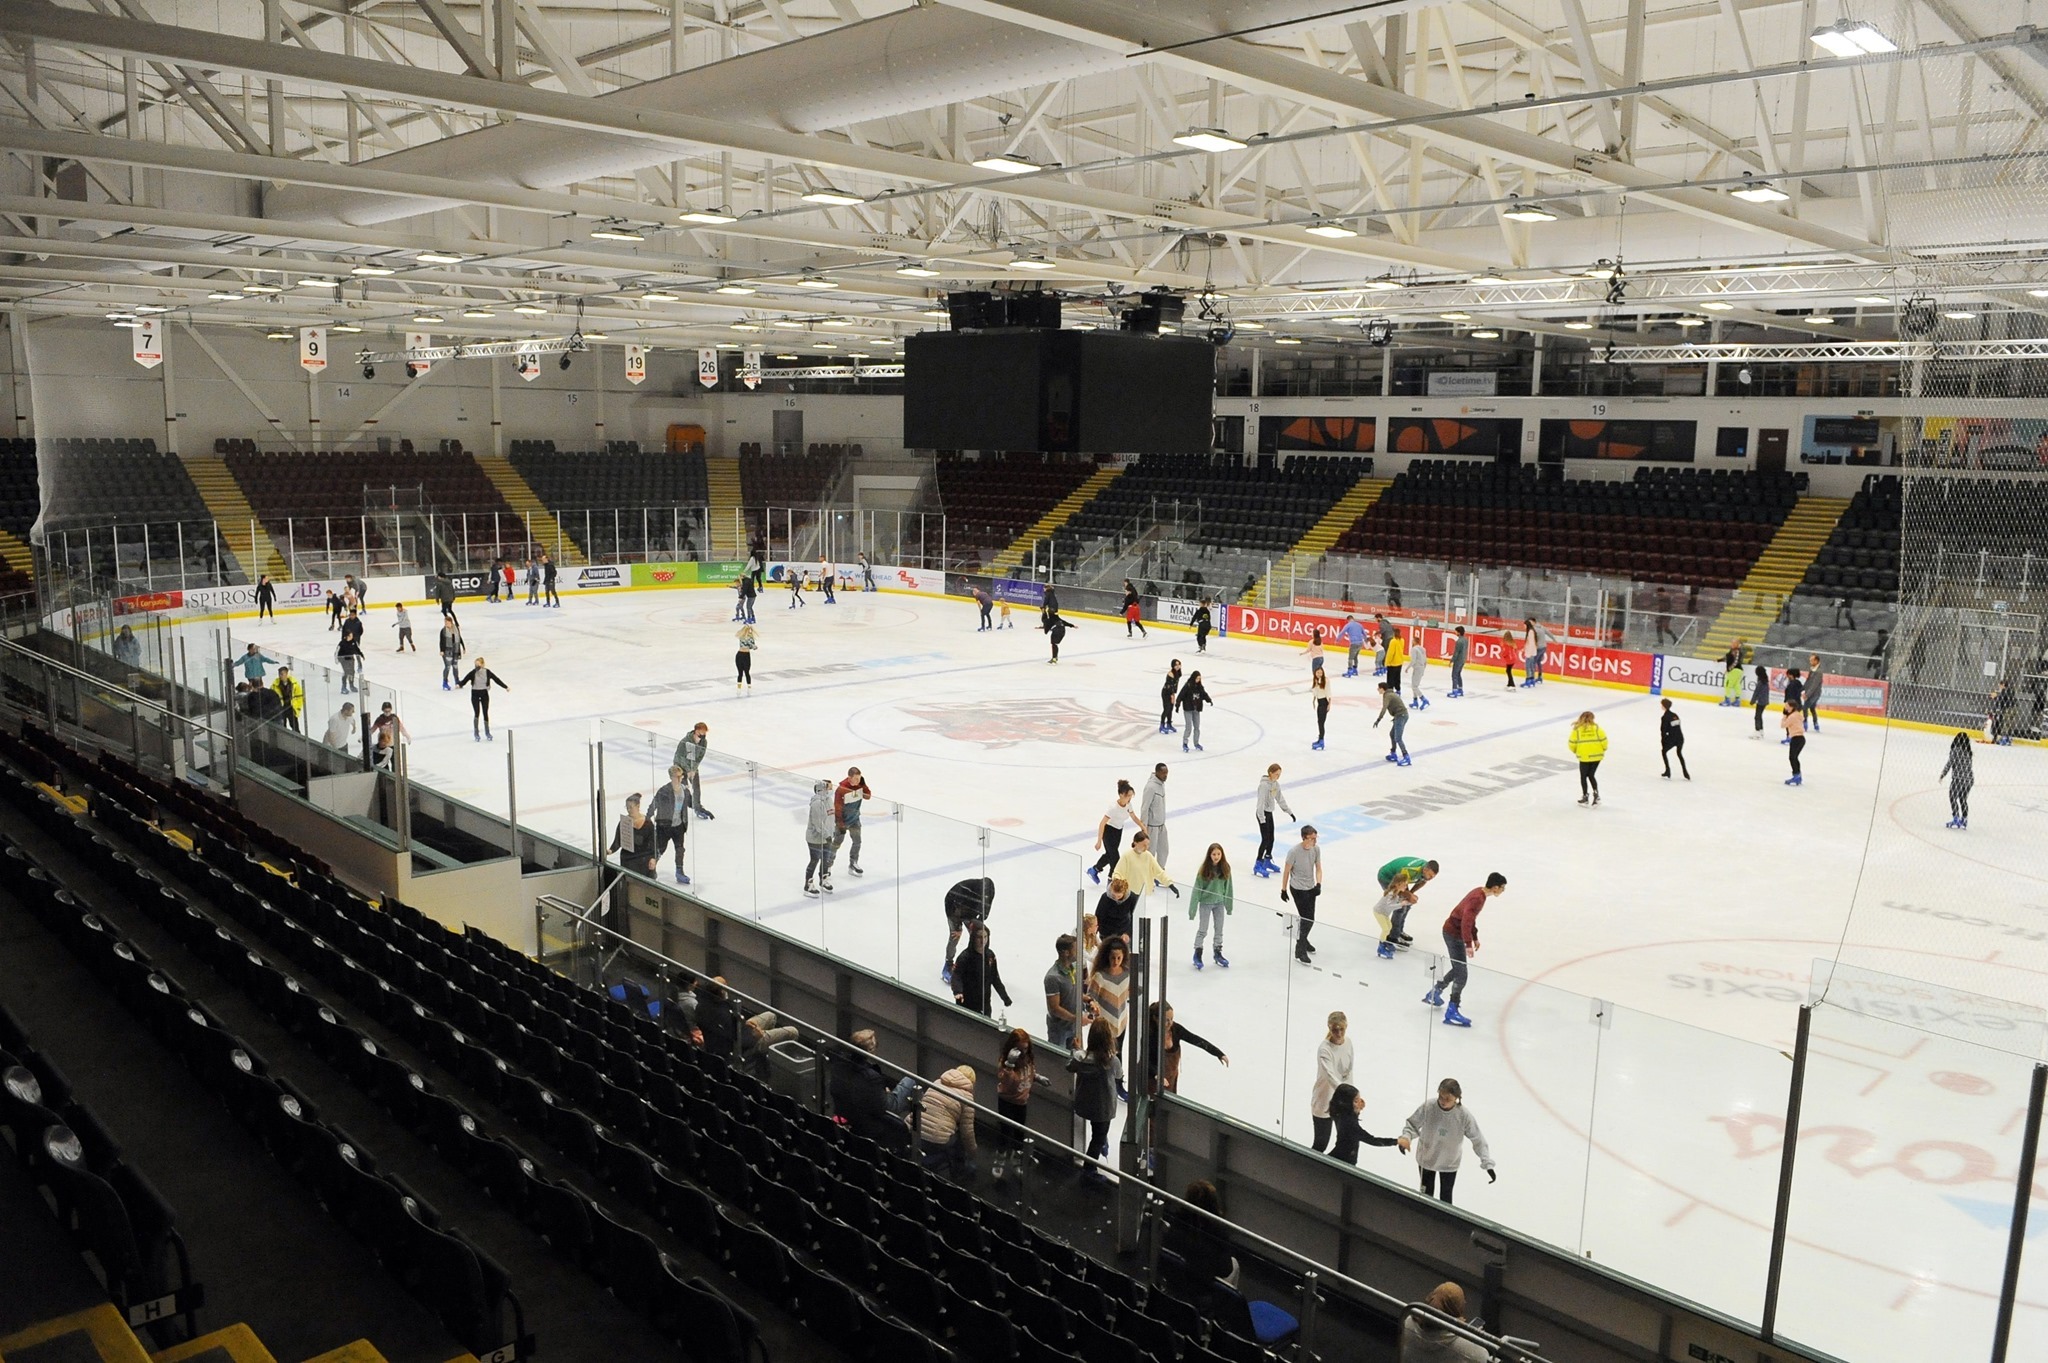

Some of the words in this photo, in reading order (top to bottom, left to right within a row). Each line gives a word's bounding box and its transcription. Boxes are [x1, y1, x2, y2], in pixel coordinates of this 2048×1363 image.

[142, 334, 153, 349] 7
[309, 342, 318, 356] 9
[628, 356, 643, 369] 19
[701, 361, 716, 373] 26
[338, 388, 350, 397] 14
[567, 394, 578, 403] 15
[785, 399, 795, 407] 16
[1249, 403, 1260, 413] 18
[1592, 404, 1606, 416] 19
[1268, 617, 1341, 639] DRAGON
[1568, 655, 1632, 676] SIGNS
[1821, 686, 1864, 698] XPRESSIONS
[145, 1301, 161, 1319] H
[491, 1350, 505, 1363] G
